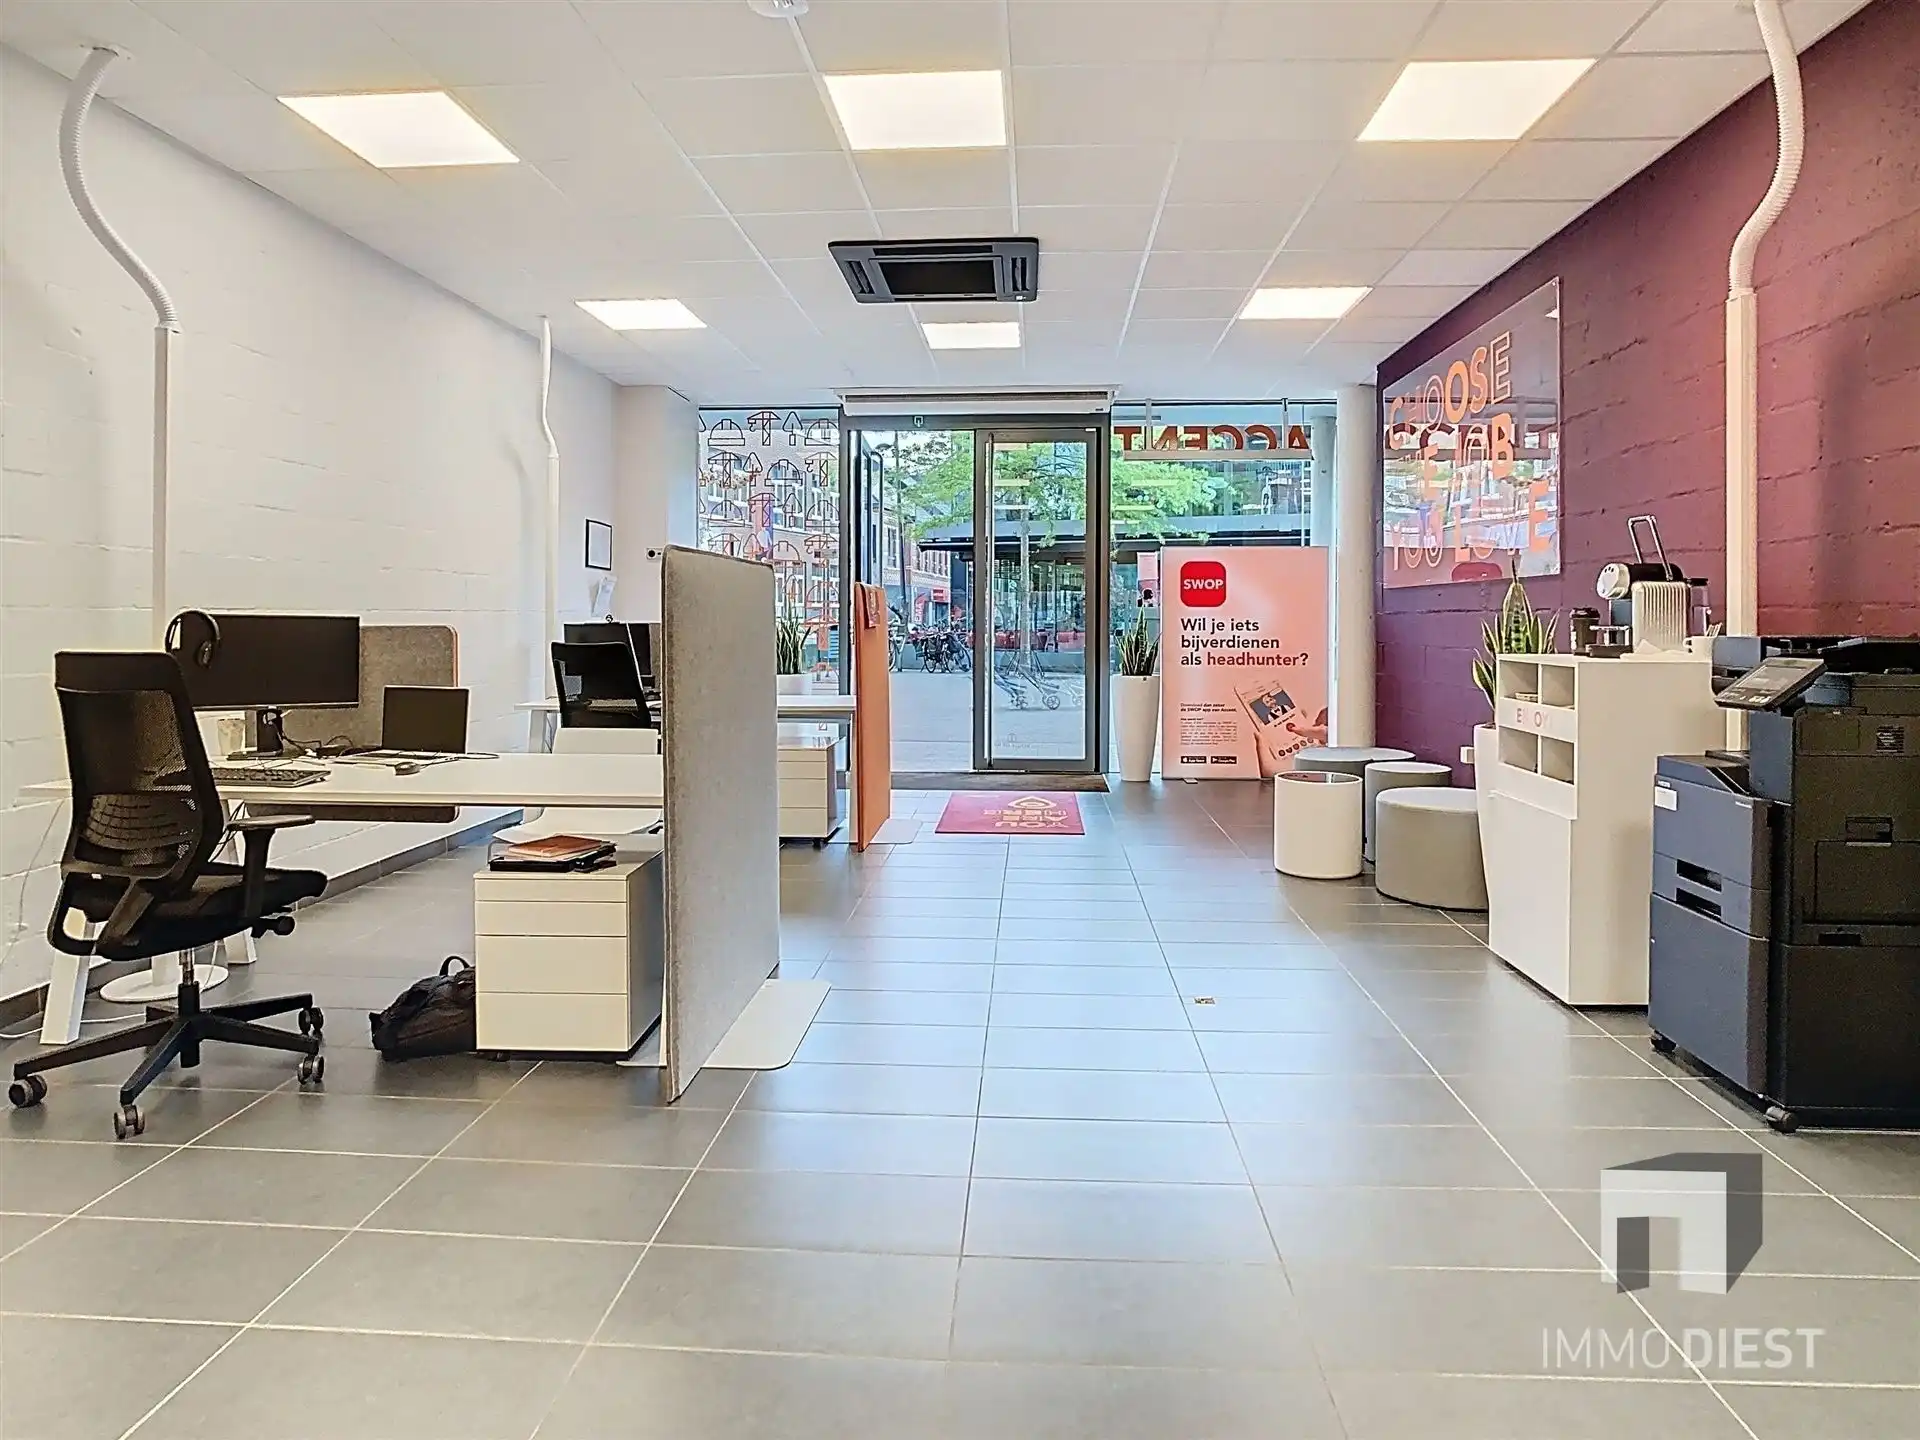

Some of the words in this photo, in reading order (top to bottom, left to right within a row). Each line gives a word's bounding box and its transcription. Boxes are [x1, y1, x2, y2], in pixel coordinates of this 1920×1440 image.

[1389, 331, 1511, 450] CHOOSE
[1183, 579, 1224, 590] SWOP
[1180, 617, 1206, 631] Wil
[1210, 617, 1225, 635] je
[1230, 617, 1260, 631] iets
[1181, 634, 1280, 652] bijverdienen
[1180, 651, 1202, 666] als
[1207, 651, 1309, 666] headhunter?
